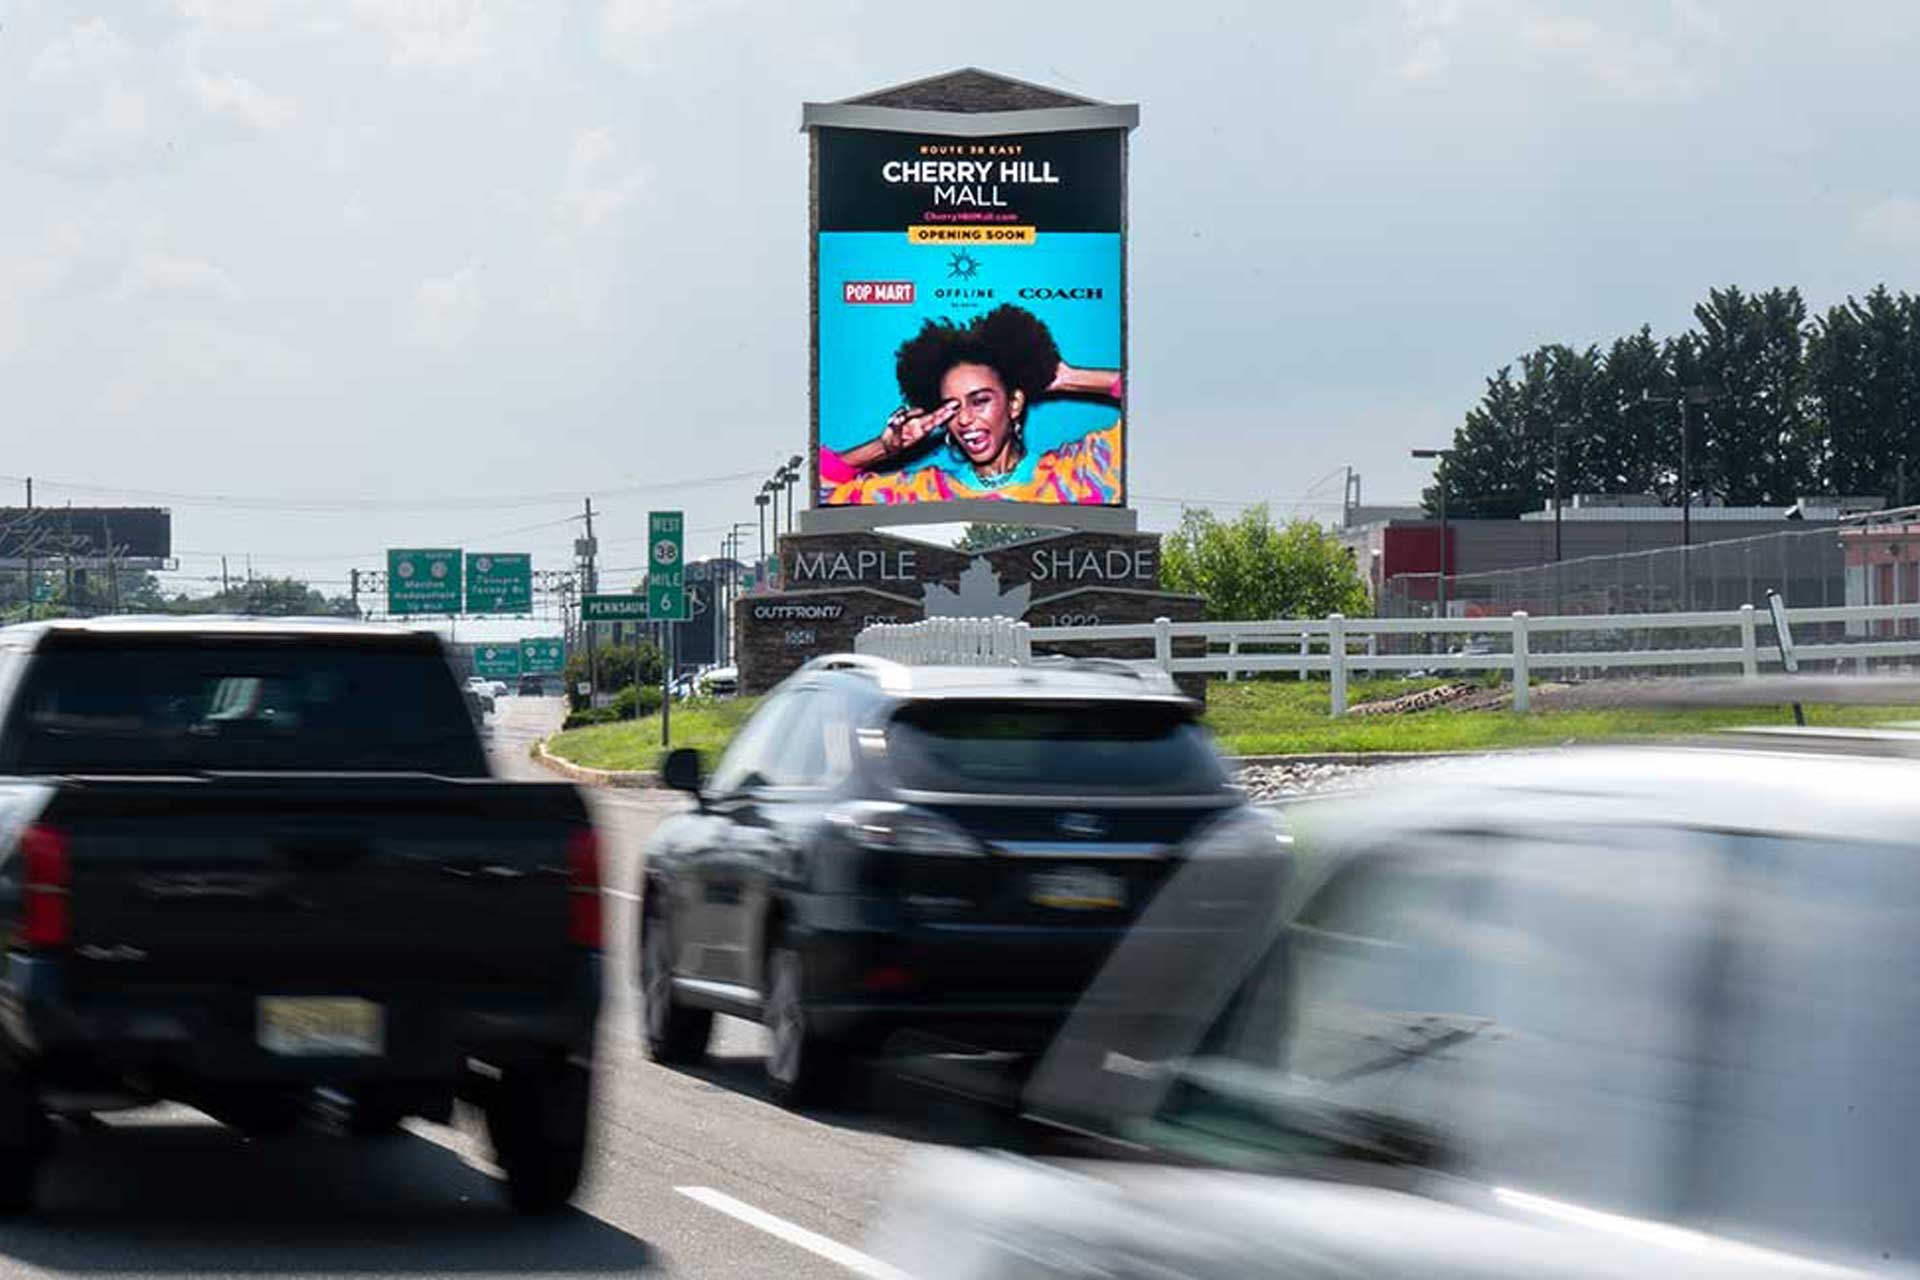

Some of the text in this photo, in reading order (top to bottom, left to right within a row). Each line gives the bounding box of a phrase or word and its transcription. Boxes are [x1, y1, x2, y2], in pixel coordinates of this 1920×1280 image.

[920, 146, 963, 154] ROUTE
[989, 146, 1023, 154] EAST
[882, 161, 1059, 183] CHERRY HILL
[933, 185, 1007, 206] MALL
[918, 229, 1025, 240] OPENING SOON
[845, 284, 912, 301] POP MART
[934, 288, 994, 298] OFFLINE
[1018, 288, 1103, 299] COACH
[651, 517, 680, 532] WEST
[656, 545, 676, 558] 38
[794, 551, 916, 581] MAPLE
[1031, 550, 1153, 580] SHADE
[650, 573, 681, 587] MILE
[660, 593, 671, 611] 6
